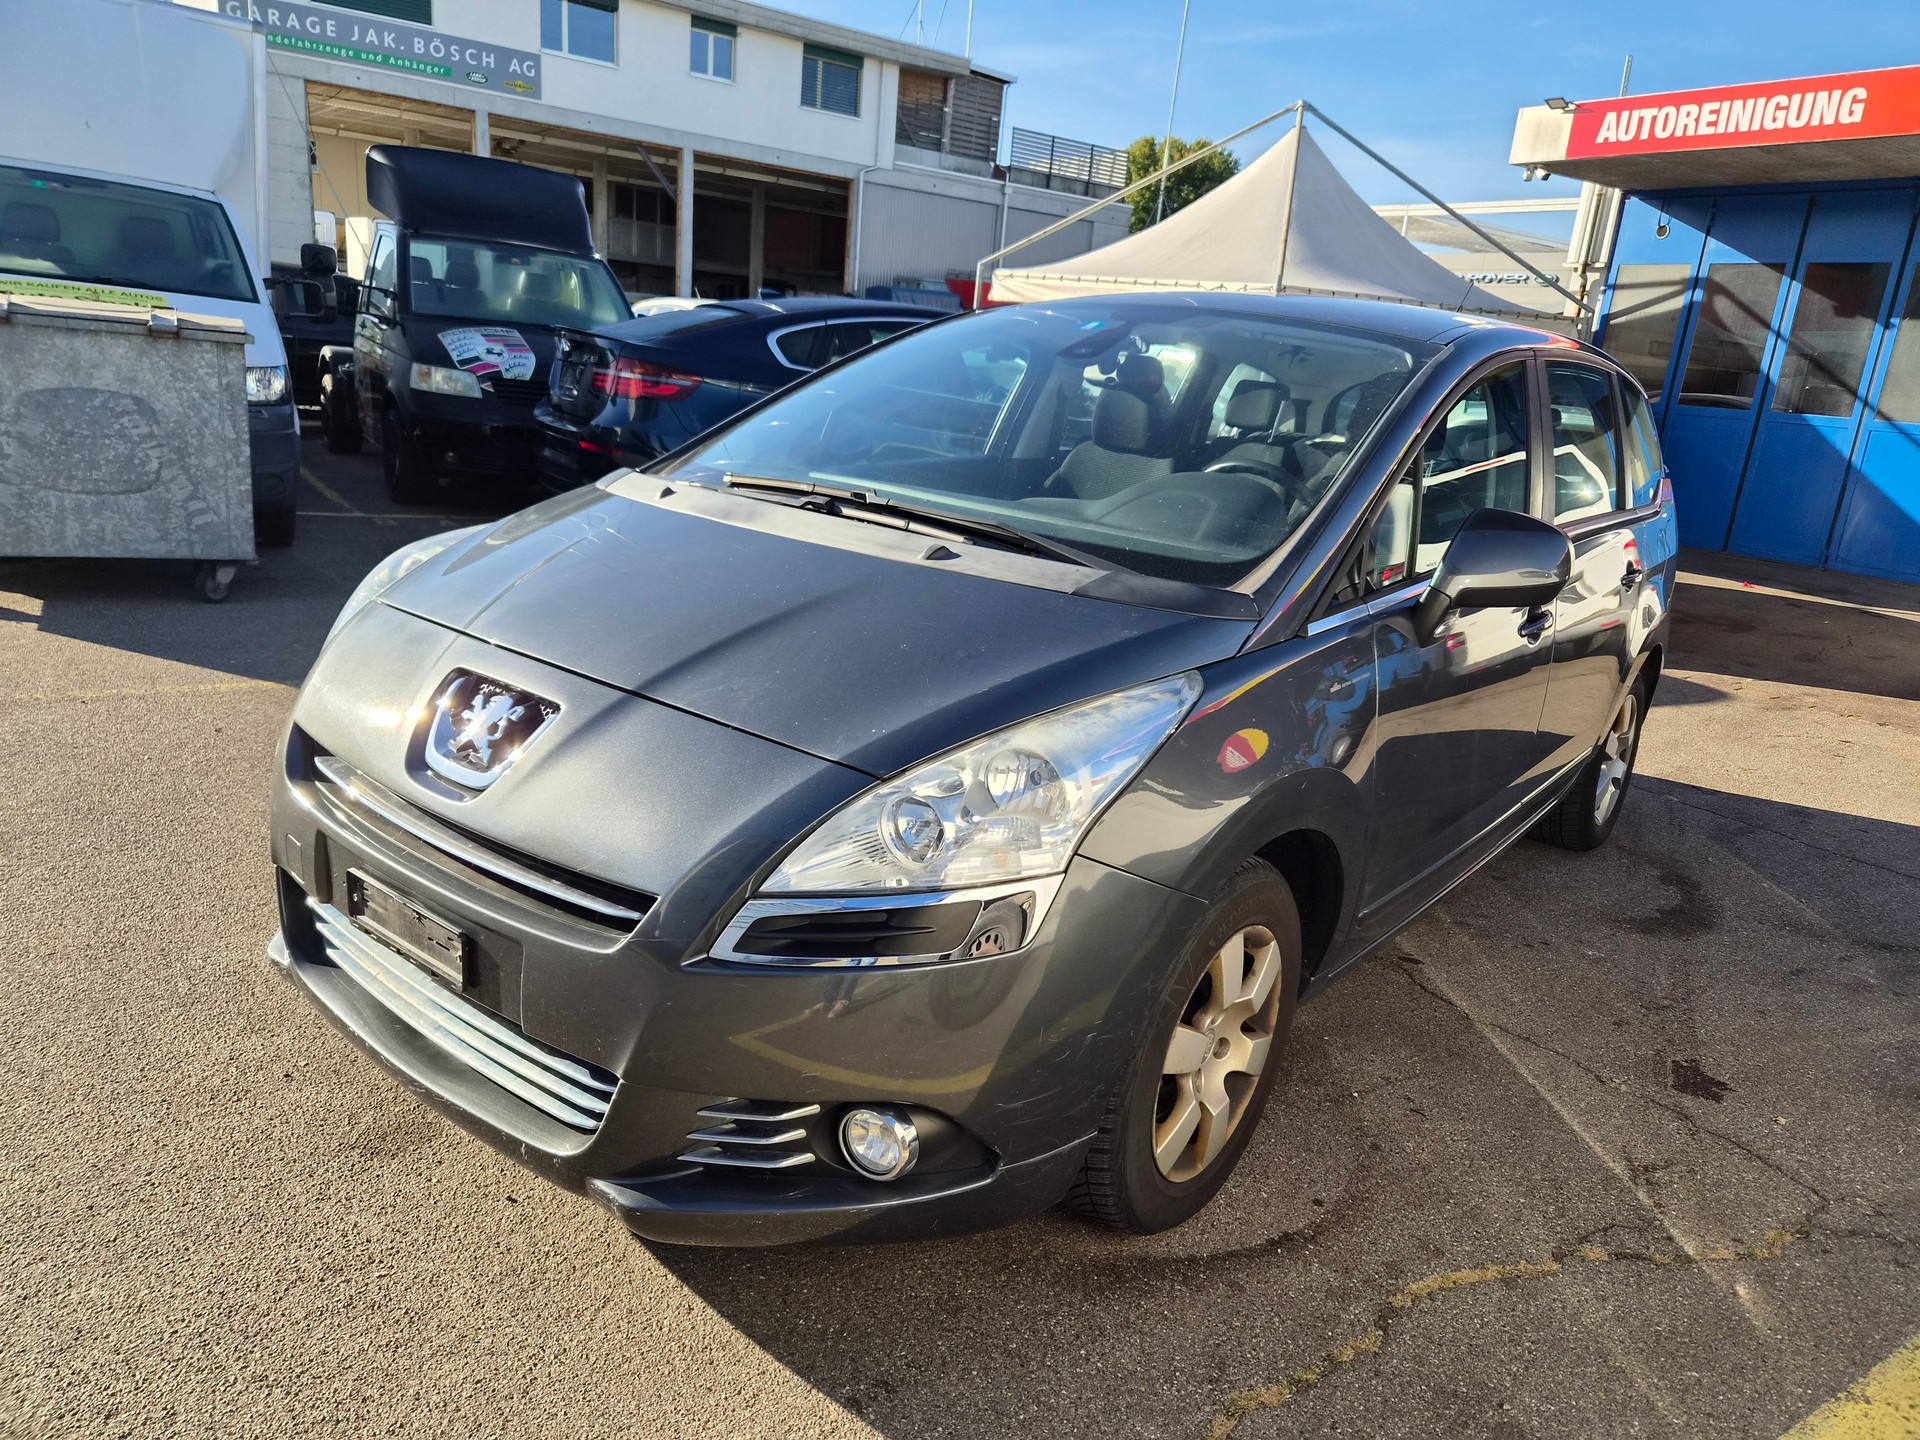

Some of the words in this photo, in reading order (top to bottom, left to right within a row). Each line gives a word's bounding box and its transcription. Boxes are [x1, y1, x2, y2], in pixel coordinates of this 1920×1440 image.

[226, 1, 336, 37] GARAGE
[351, 25, 404, 50] JAK.
[413, 37, 494, 68] BÖSCH
[509, 58, 535, 76] AG
[267, 34, 354, 57] ndefahrzeuge
[361, 52, 382, 62] und
[389, 57, 444, 74] Anhänger
[1595, 87, 1867, 143] AUTOREINIGUNG
[26, 282, 81, 291] KAUFEN
[85, 287, 116, 296] ALLE
[121, 291, 163, 302] AUTOS
[1467, 272, 1528, 284] ROVER
